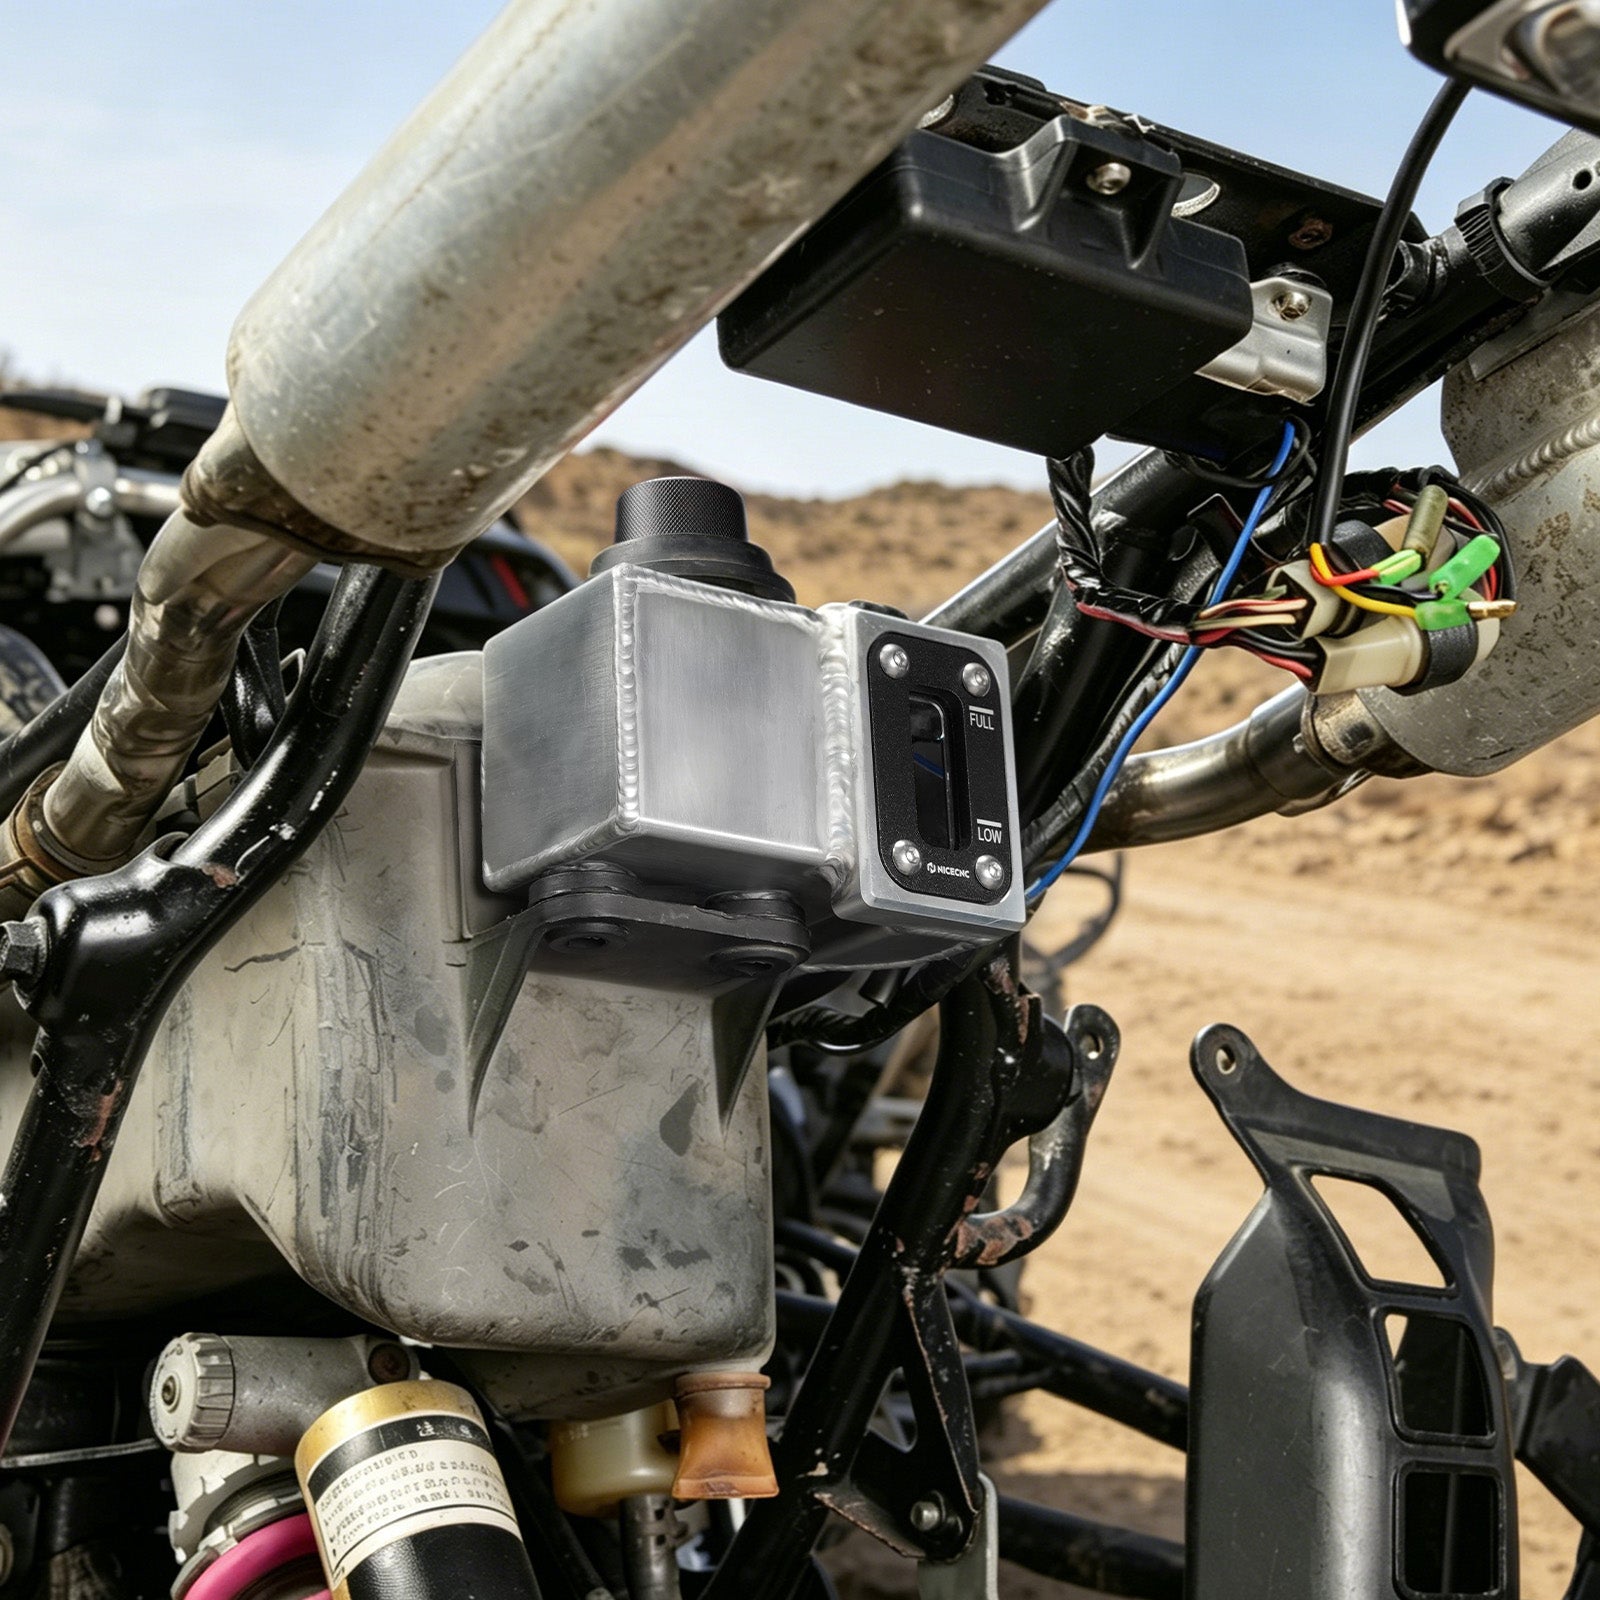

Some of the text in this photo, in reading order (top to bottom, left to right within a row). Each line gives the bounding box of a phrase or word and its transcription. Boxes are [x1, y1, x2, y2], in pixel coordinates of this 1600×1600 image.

[969, 712, 995, 730] FULL
[977, 827, 1002, 844] LOW
[937, 864, 970, 878] NICECNC
